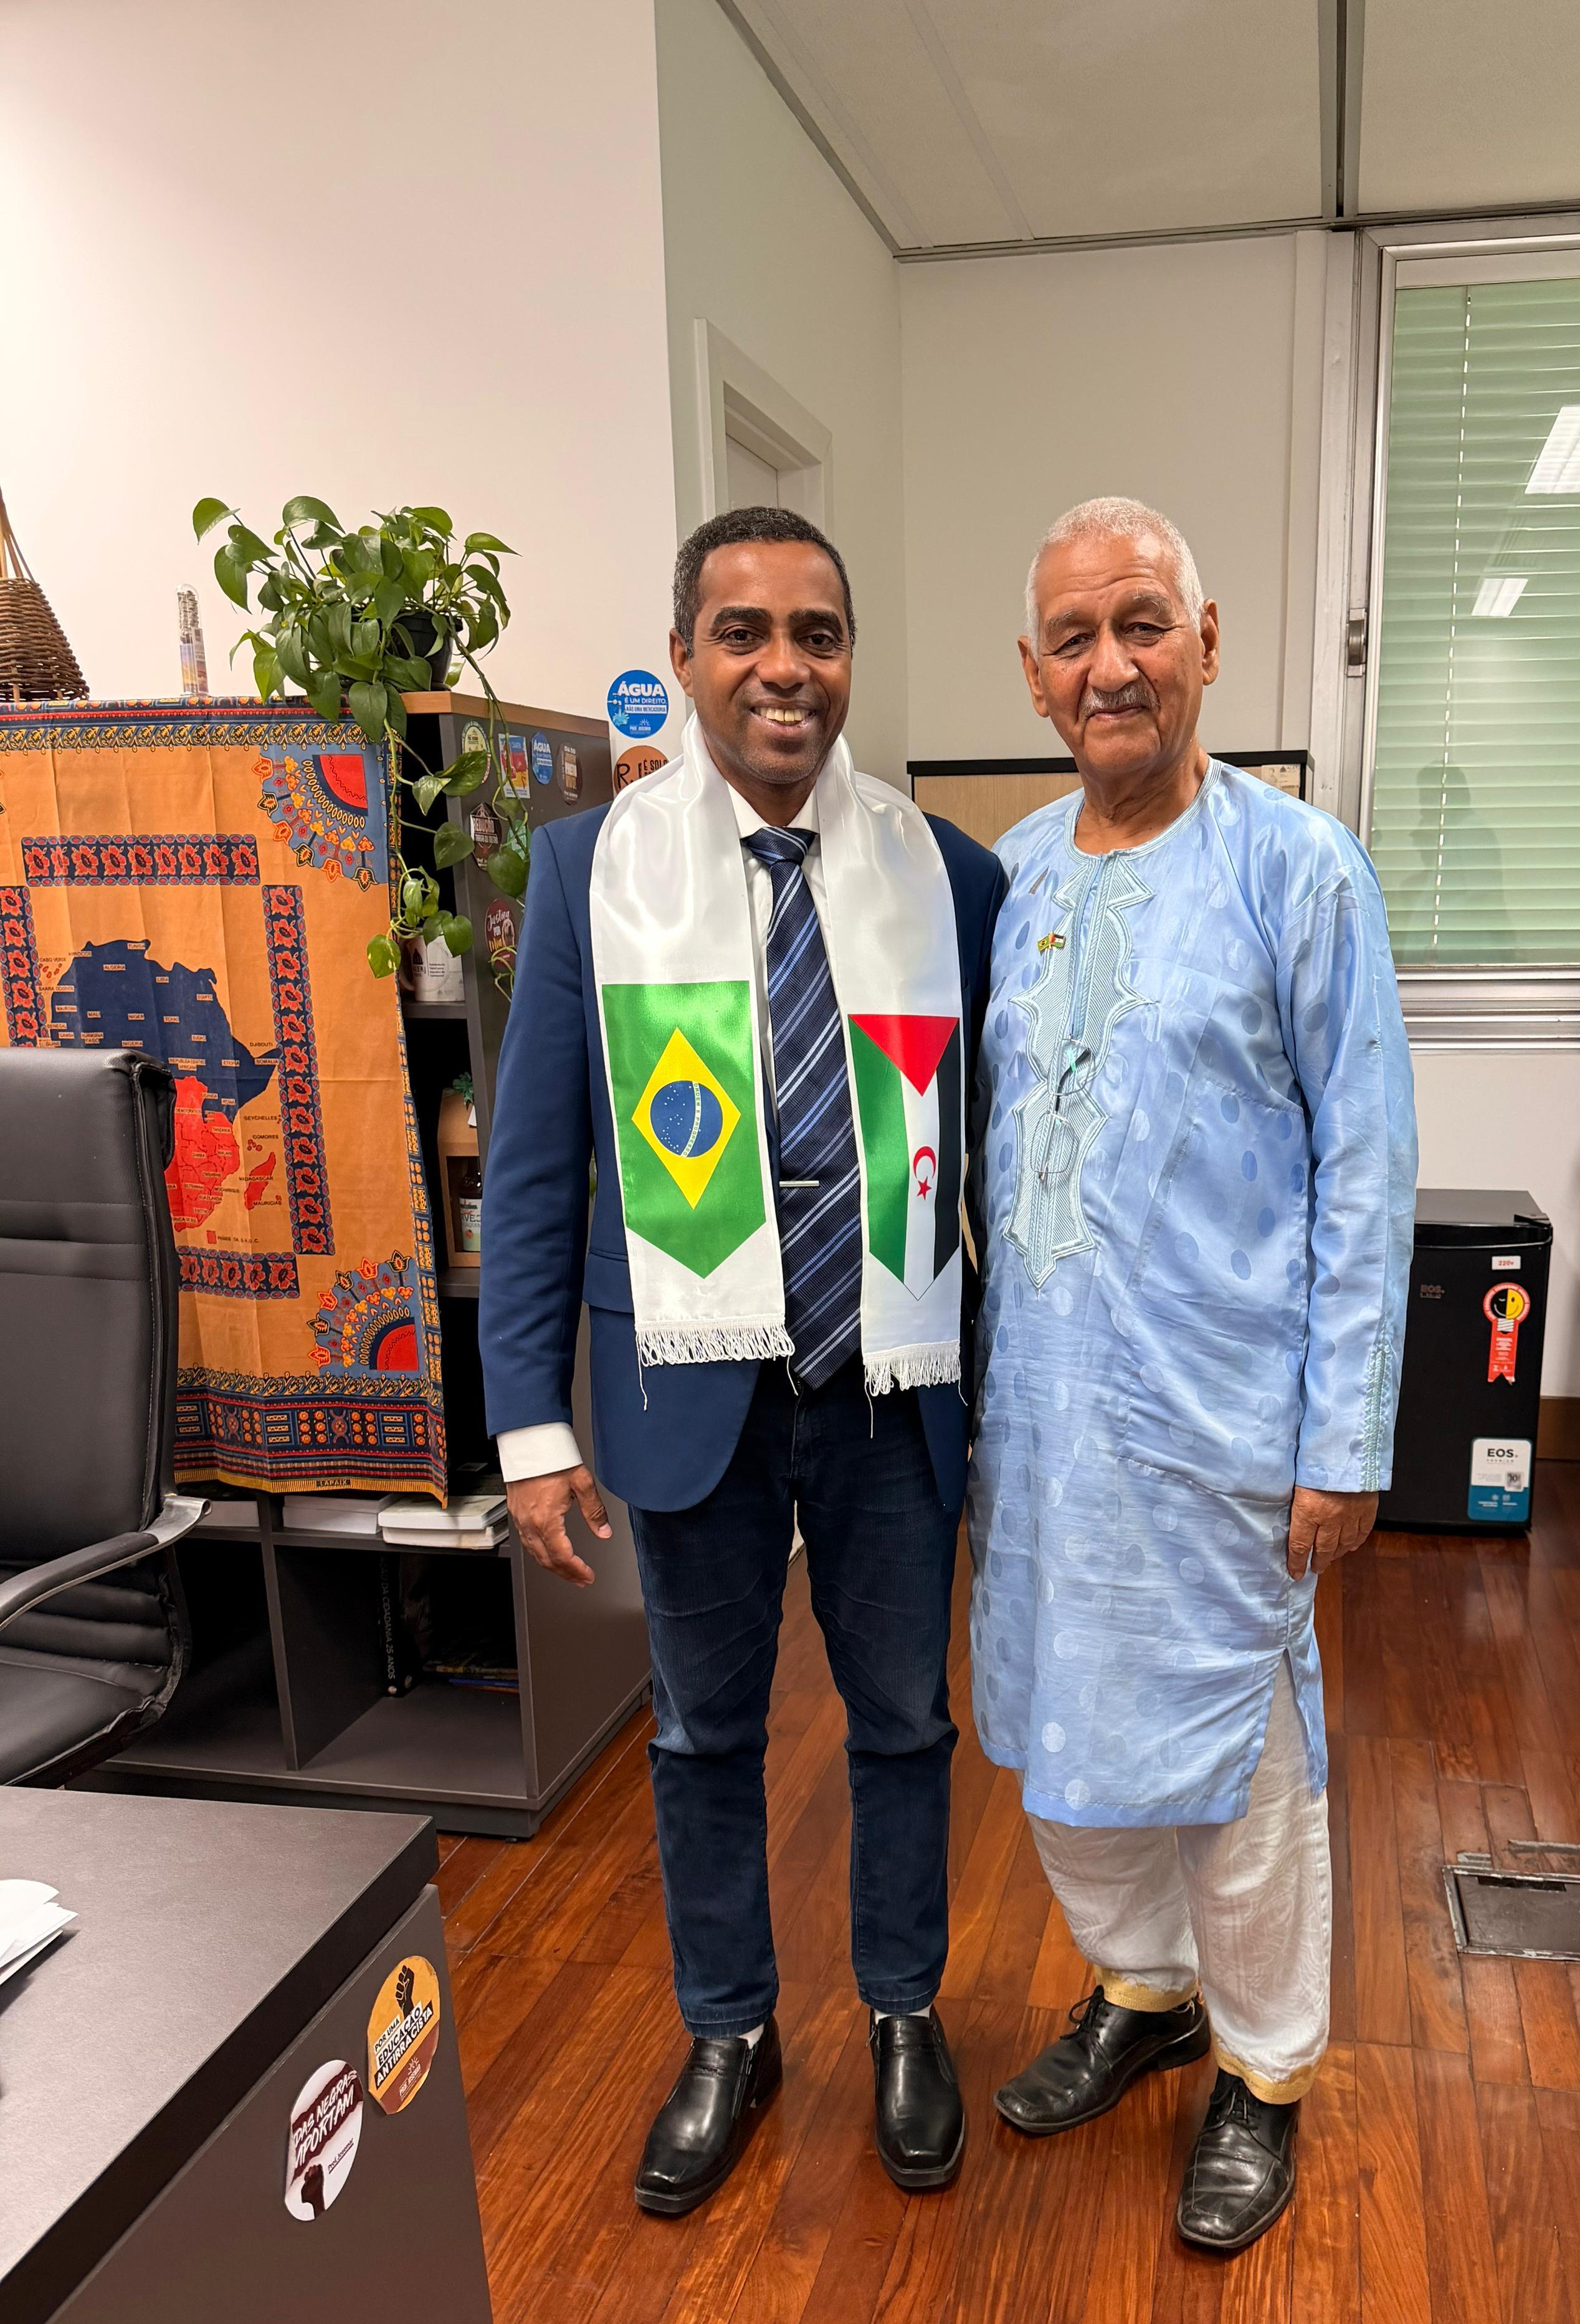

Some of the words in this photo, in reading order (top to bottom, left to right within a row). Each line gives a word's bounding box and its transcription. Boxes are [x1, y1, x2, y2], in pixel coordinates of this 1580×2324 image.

[618, 681, 665, 696] ÁGUA
[533, 740, 551, 754] ÁGUA
[644, 758, 648, 770] É
[683, 1116, 700, 1156] PROGRESSO
[383, 1596, 393, 1642] CIDADANIA
[386, 1643, 394, 1654] 25
[387, 1655, 396, 1680] ANOS
[374, 2035, 387, 2052] POR
[386, 2018, 400, 2036] UMA
[376, 2007, 433, 2087] ANTIRRACISTA
[378, 2007, 421, 2066] EDUCAÇÃO
[316, 2070, 358, 2122] NEGRAS
